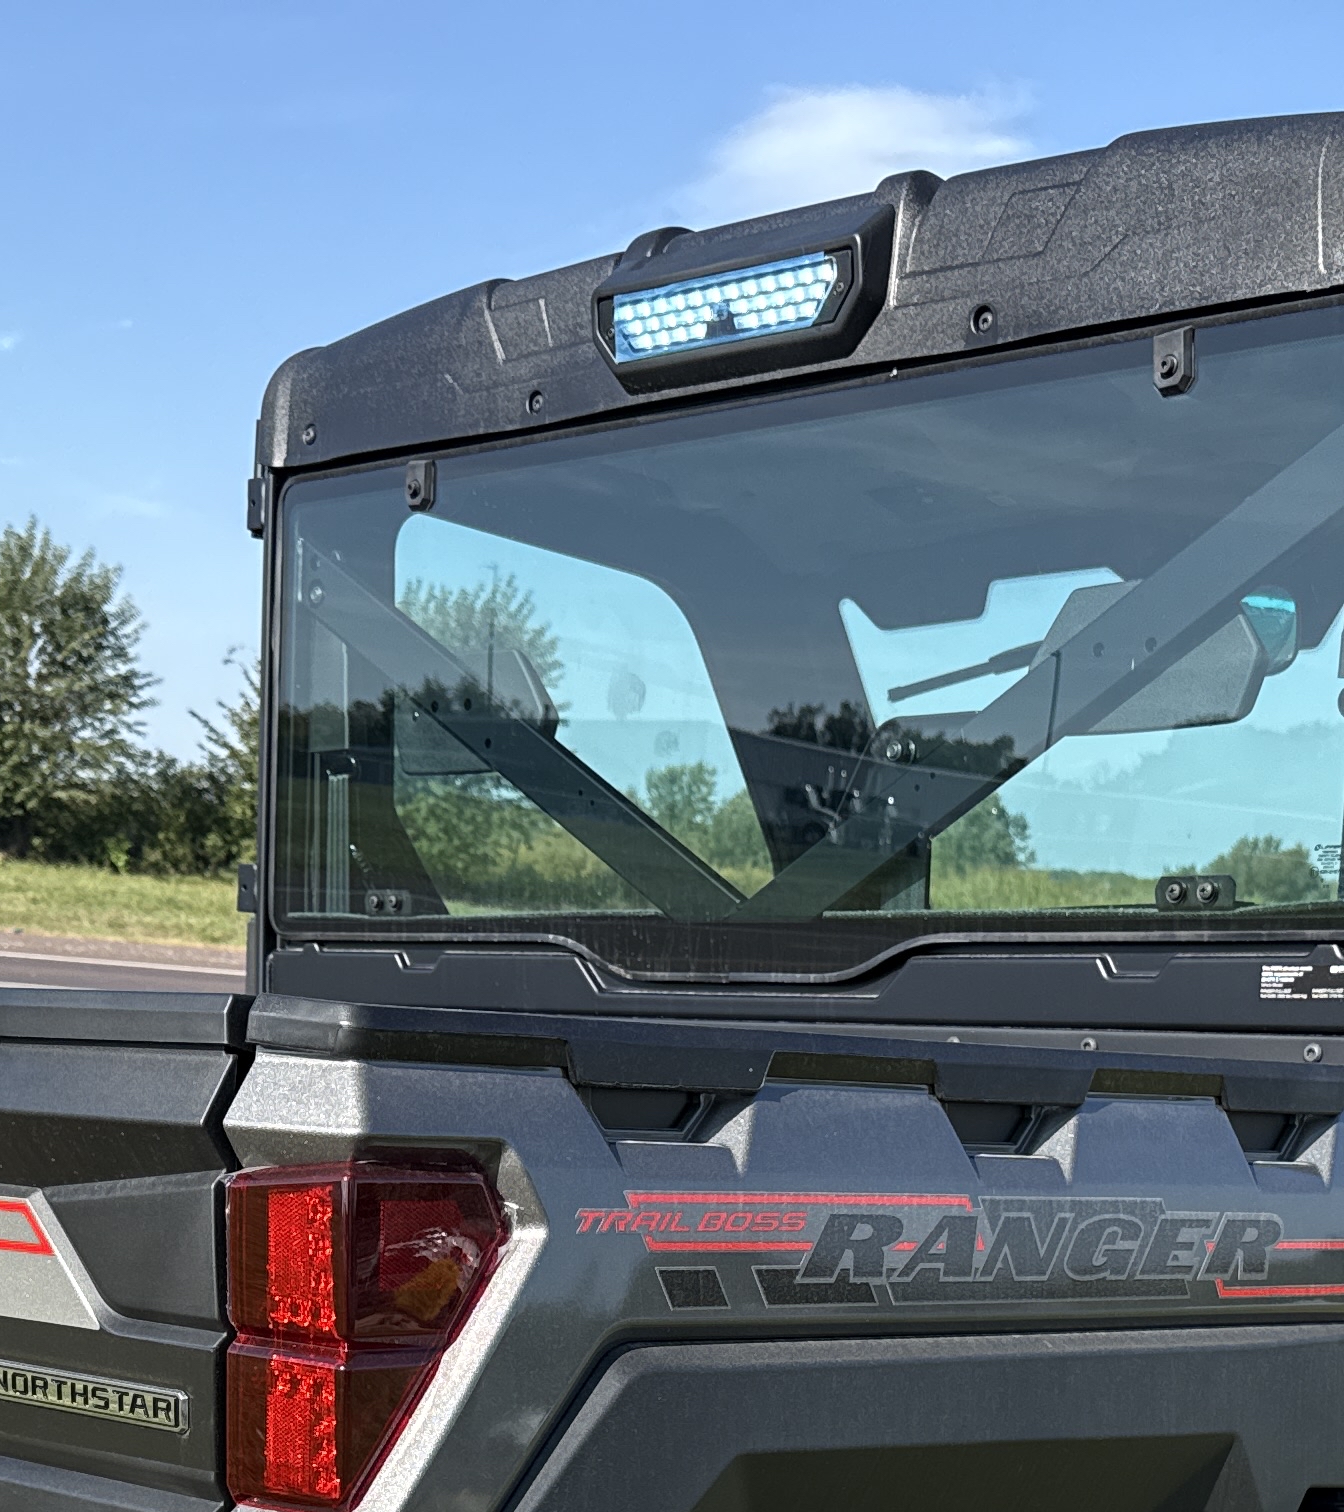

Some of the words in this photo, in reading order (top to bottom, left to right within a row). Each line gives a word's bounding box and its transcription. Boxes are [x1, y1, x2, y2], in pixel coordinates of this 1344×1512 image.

[574, 1208, 690, 1234] TRAIL
[696, 1210, 807, 1233] BOSS
[795, 1211, 1285, 1283] RANGER
